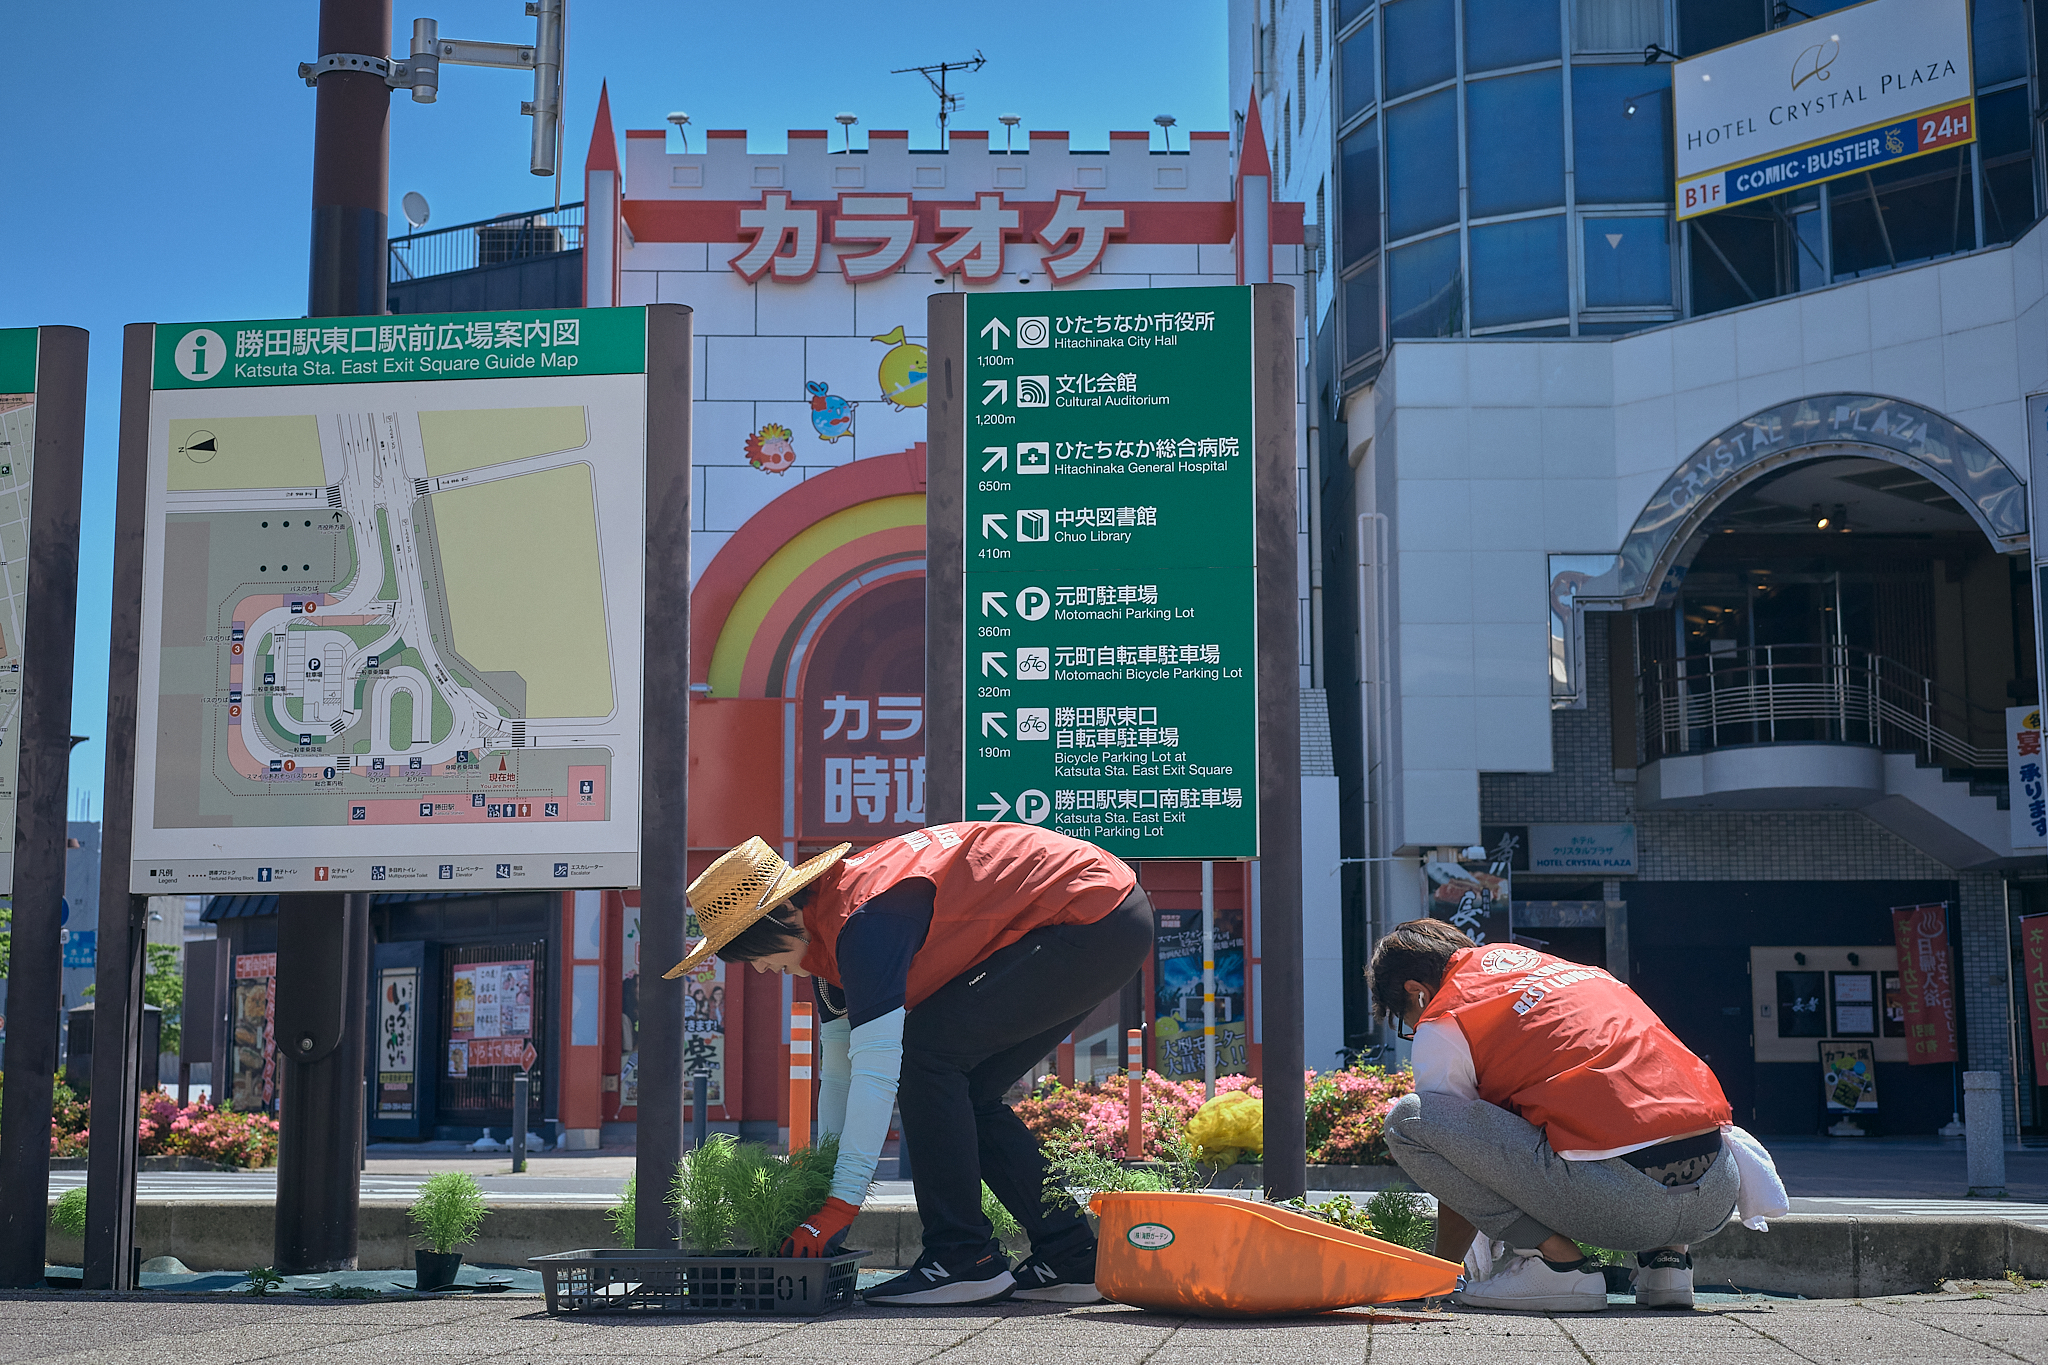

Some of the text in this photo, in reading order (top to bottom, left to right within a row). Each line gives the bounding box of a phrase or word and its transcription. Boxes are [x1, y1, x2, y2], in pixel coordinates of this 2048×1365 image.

[1687, 60, 1956, 150] HOTEL CRYSTAL PLAZA
[1922, 114, 1968, 145] 24H
[1685, 182, 1721, 209] B1F
[728, 190, 1129, 285] カラオケ
[1055, 311, 1215, 334] ひたちなか市役所
[234, 319, 580, 359] 勝田駅東口駅前広場案内図
[1054, 335, 1177, 350] Hitachinaka City Hall
[234, 352, 578, 378] Katsuta Sta. East Exit Square Guide Map
[977, 355, 1014, 367] 1,100m
[1055, 373, 1137, 394] 文化会館
[1055, 394, 1170, 407] Cultural Auditorium
[975, 414, 1016, 426] 1,200m
[1055, 437, 1239, 459] ひたちなか総合病院
[1669, 406, 1928, 510] CRYSTAL PLAZA
[1054, 460, 1227, 475] Hitachinaka General Hospital
[978, 481, 1011, 492] 650m
[1055, 506, 1157, 528] 中央図書館
[1054, 530, 1132, 543] Chuo Library
[978, 548, 1011, 559] 410m
[1055, 585, 1158, 606] 元町駐車場
[1054, 607, 1195, 621] Motomachi Parking Lot
[978, 627, 1011, 637] 360m
[234, 645, 241, 653] 3
[1054, 644, 1220, 667] 元町自転車駐車場
[1054, 667, 1243, 681] Motomachi Bicycle Parking Lot
[978, 687, 1011, 698] 320m
[823, 695, 923, 740] カラ
[1055, 706, 1157, 727] 勝田駅東口
[1055, 727, 1179, 749] 自転車駐車場
[978, 748, 1011, 758] 190m
[1055, 751, 1187, 766] Bicycle Parking Lot at
[489, 773, 515, 782] 現在地
[1055, 764, 1233, 778] Katsuta Sta. East Exit Square
[1055, 788, 1242, 810] 勝田駅東口南駐車場
[1055, 811, 1186, 824] Katsuta Sta. East Exit
[1094, 825, 1140, 839] Parking
[1144, 825, 1164, 836] Lot
[1571, 836, 1595, 845] ホテル
[1553, 847, 1613, 855] クリスタルプラザ
[1537, 859, 1631, 867] HOTEL CRYSTAL PLAZA
[158, 869, 173, 877] 凡例
[1512, 982, 1552, 1016] BEST
[777, 1275, 807, 1301] 01
